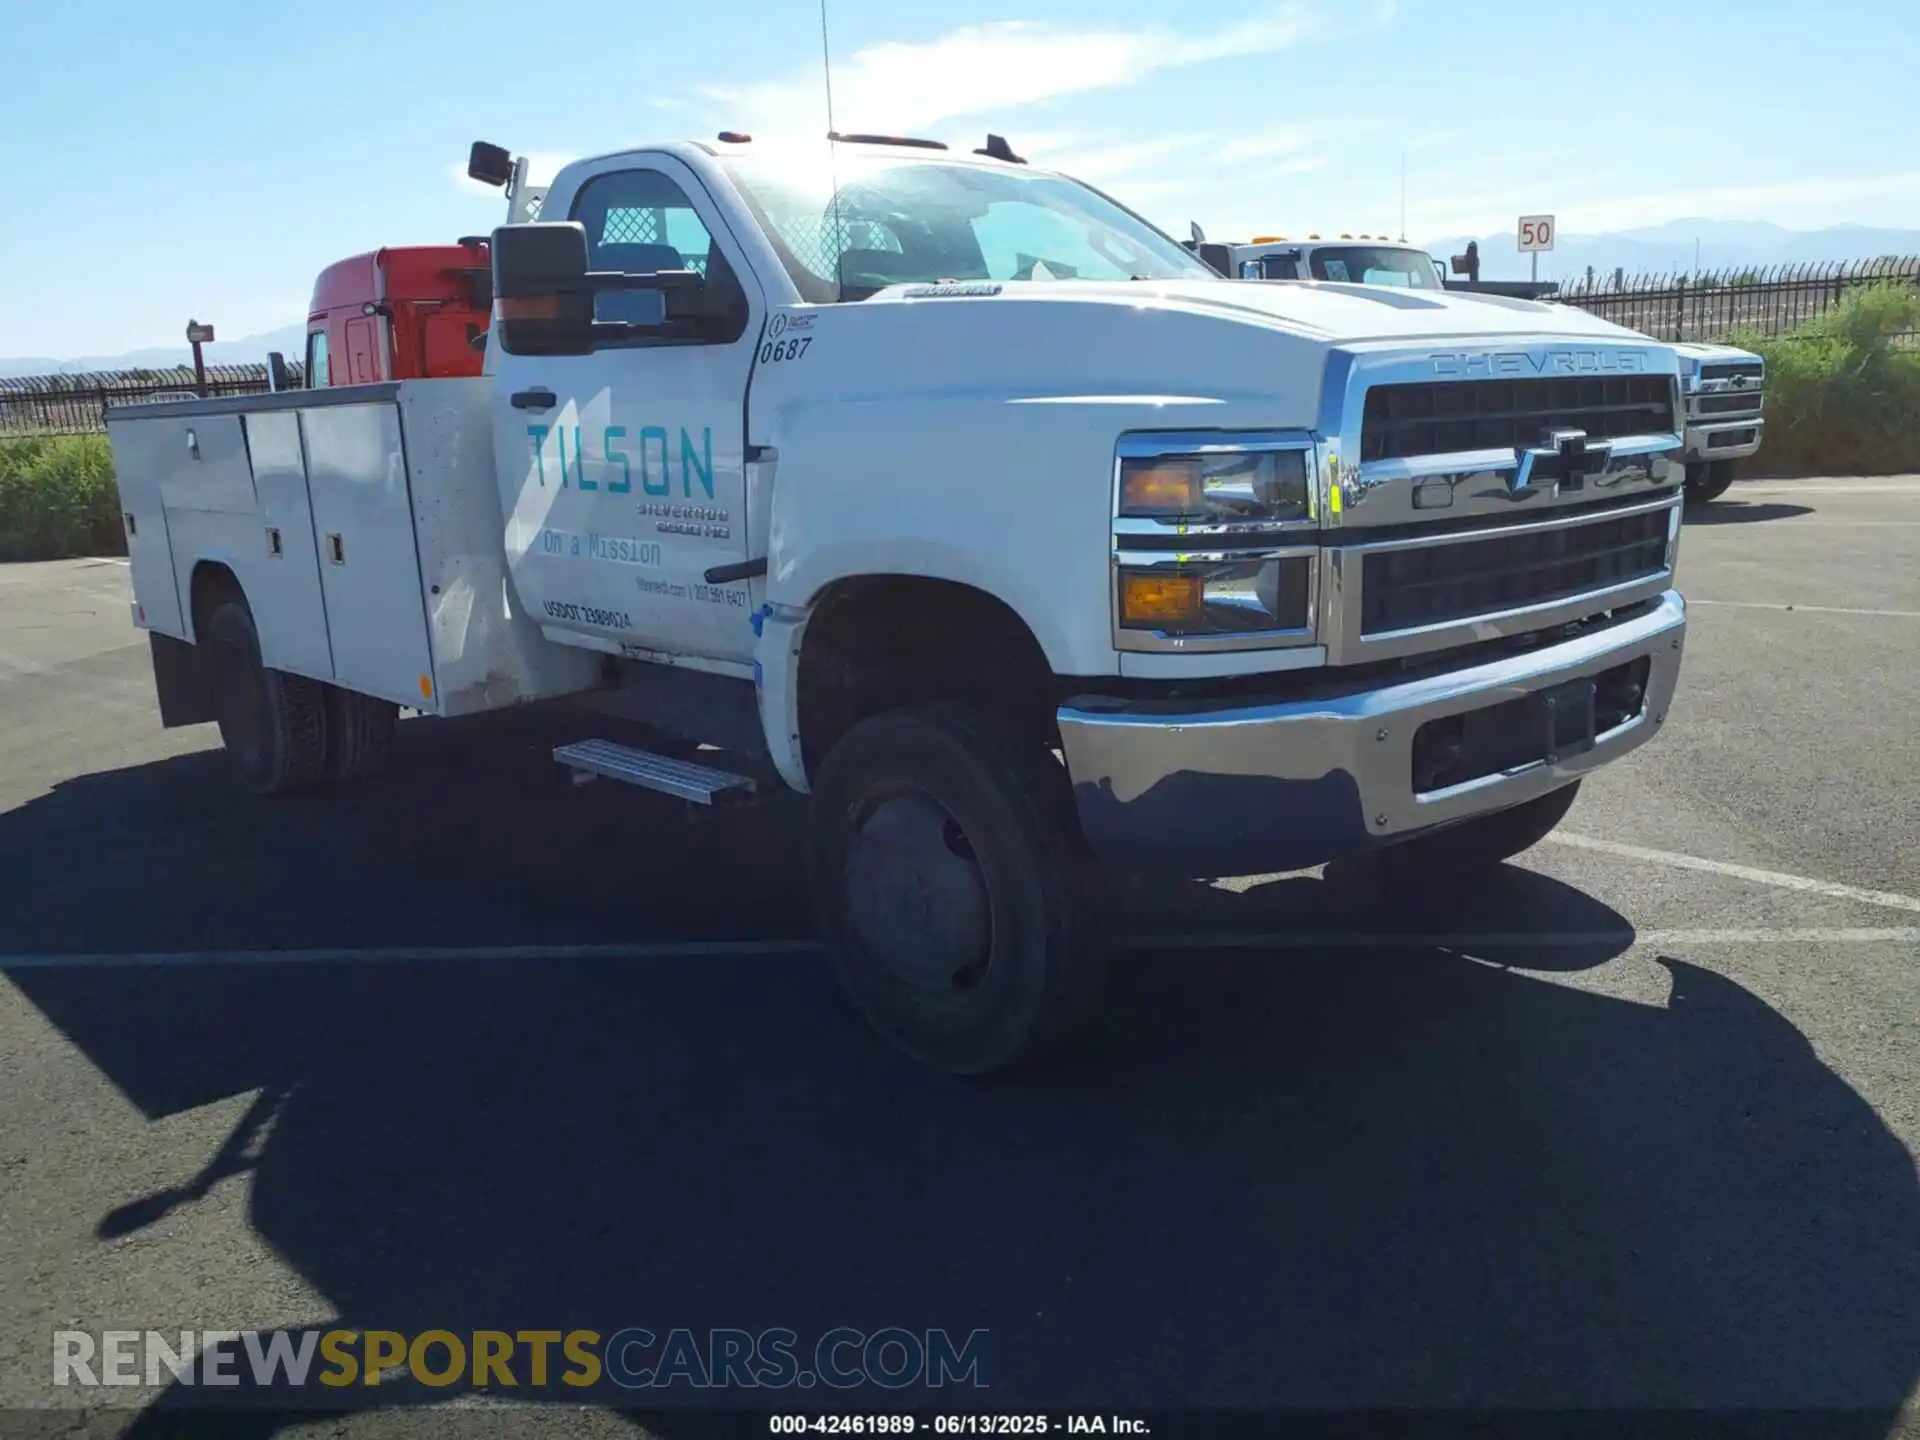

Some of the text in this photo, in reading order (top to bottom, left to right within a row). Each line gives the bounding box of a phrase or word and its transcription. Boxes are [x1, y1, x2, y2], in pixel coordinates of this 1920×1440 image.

[1522, 222, 1550, 245] 50
[760, 336, 813, 364] 0687
[1428, 351, 1648, 376] CHEVROLET
[527, 424, 715, 499] TILSON
[544, 529, 660, 567] On a Mission
[543, 599, 582, 620] USDOT
